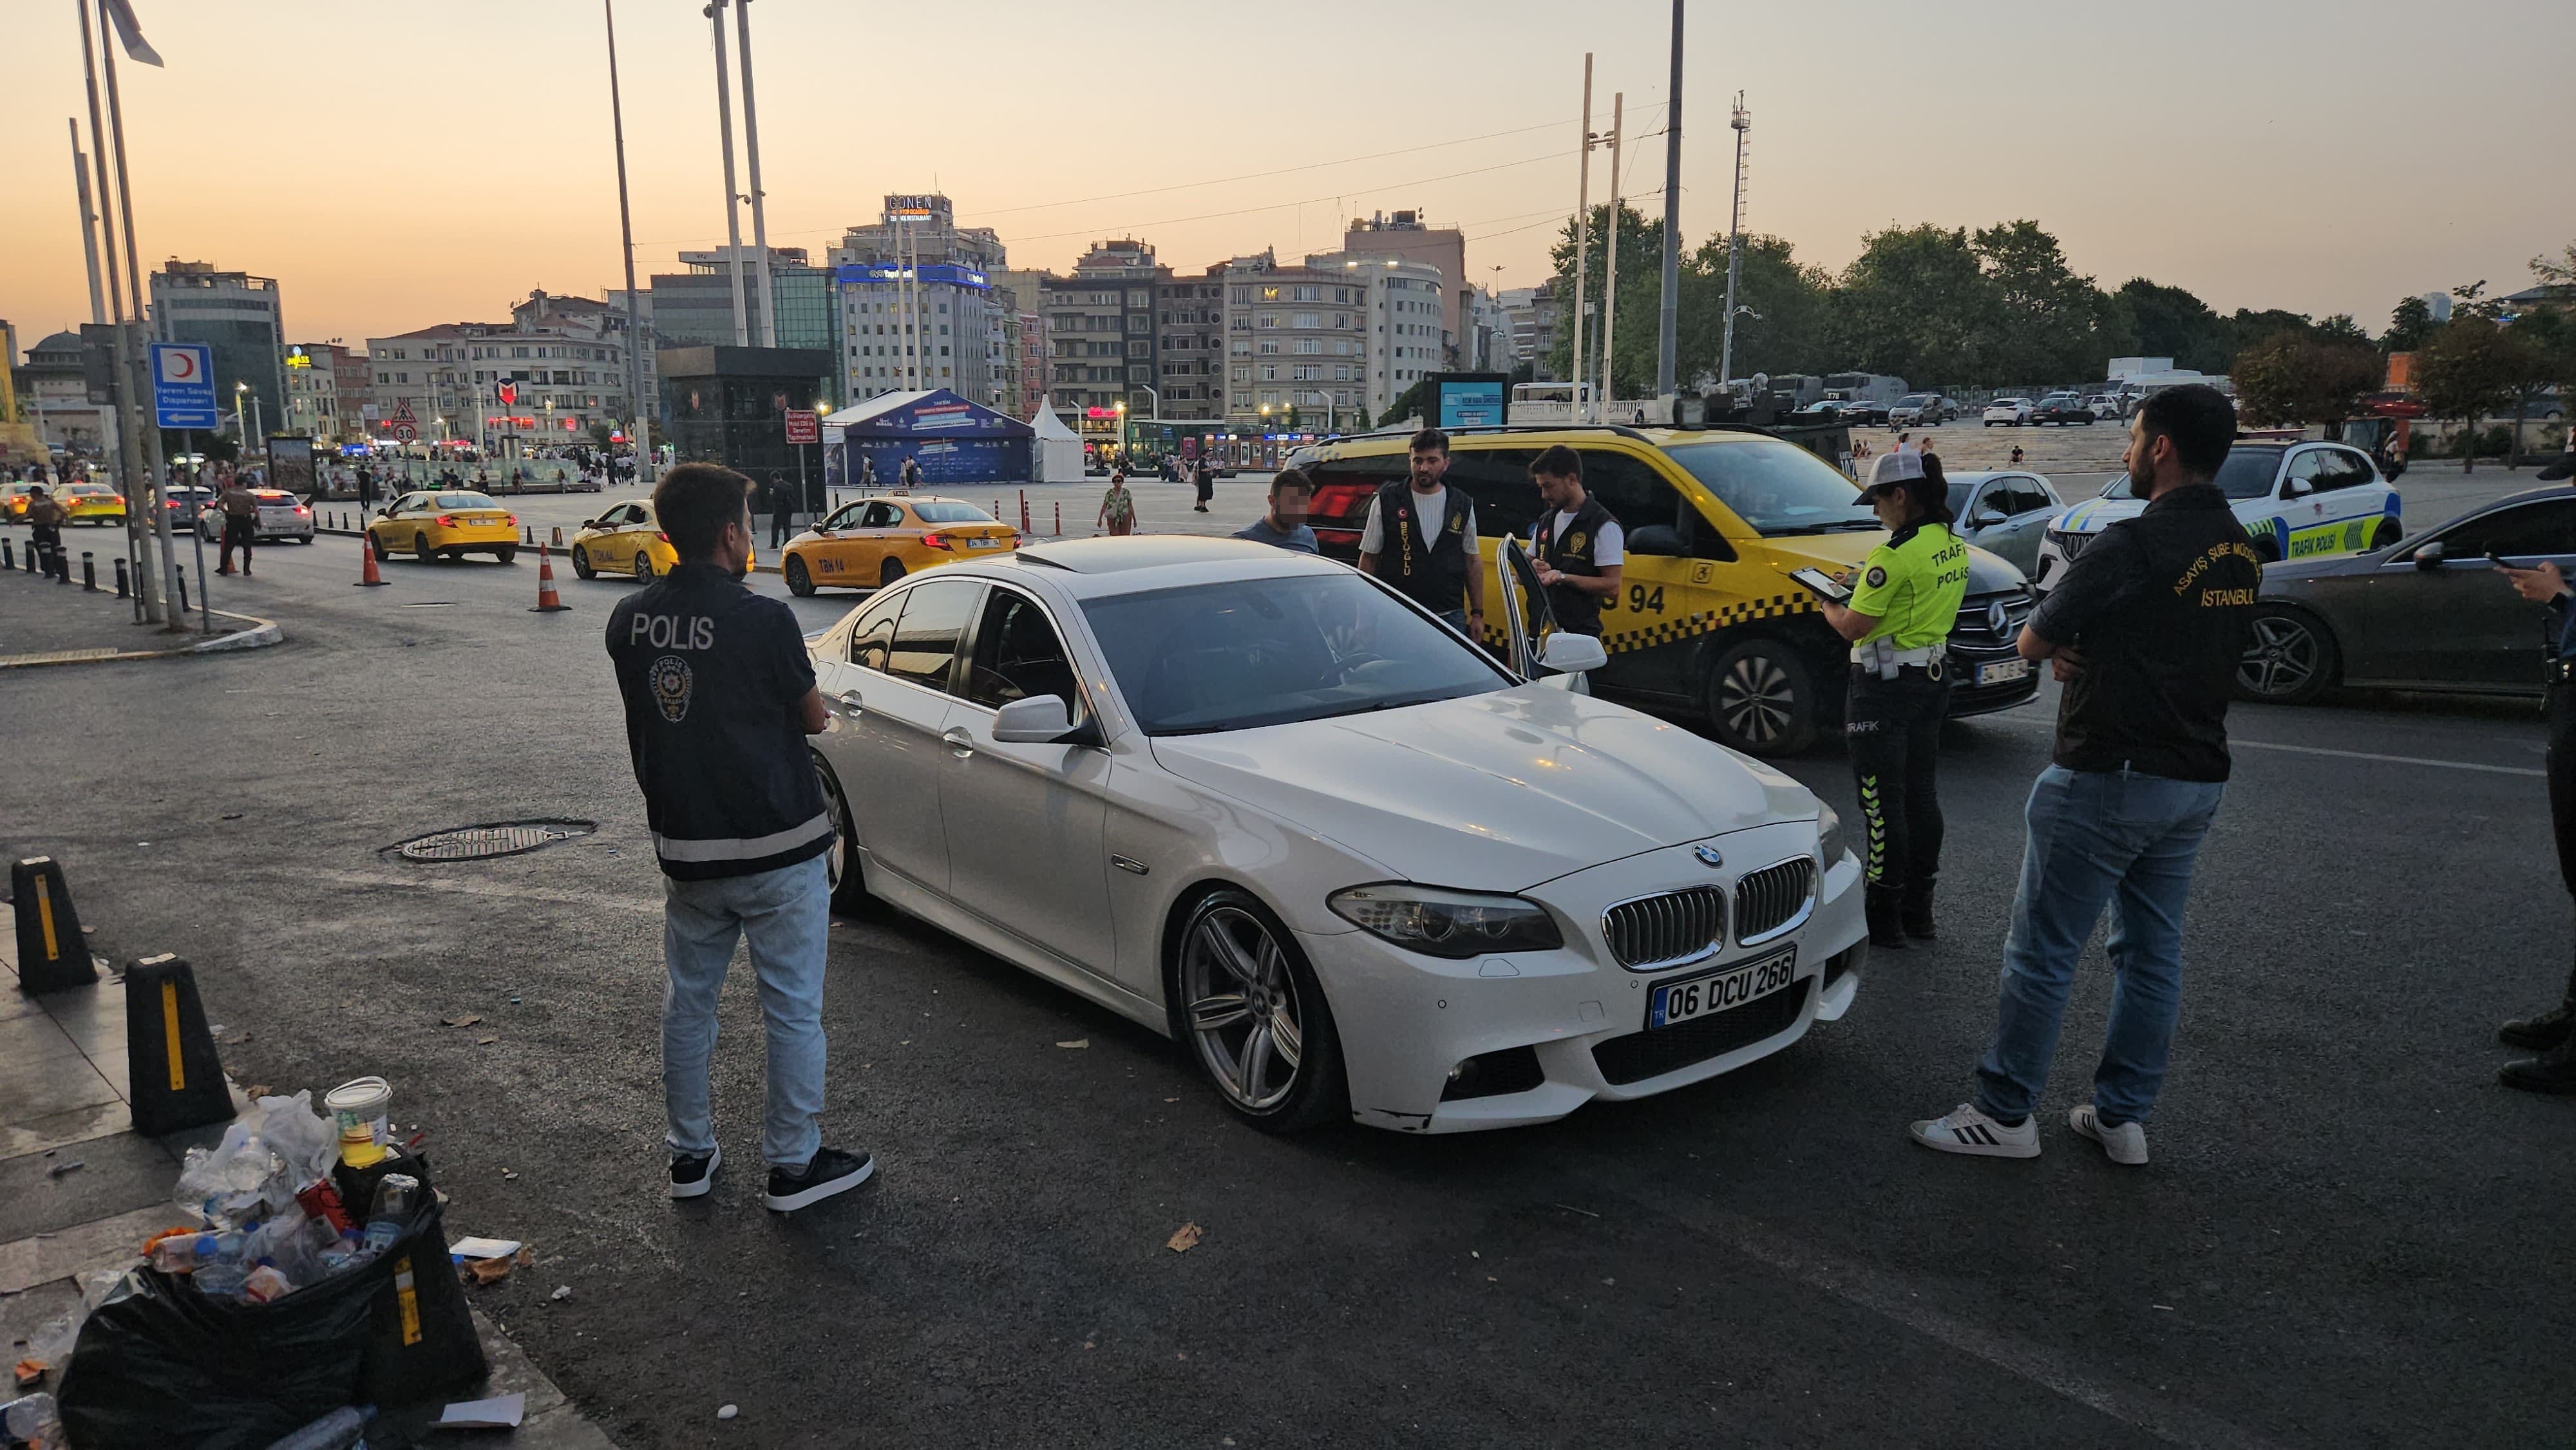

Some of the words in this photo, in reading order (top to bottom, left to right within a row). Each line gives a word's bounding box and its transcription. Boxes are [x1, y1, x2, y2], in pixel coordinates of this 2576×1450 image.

[398, 429, 413, 439] 30
[1931, 543, 1966, 567] TRAFİ
[1629, 584, 1665, 615] 94
[2201, 587, 2254, 607] İSTANBUL
[1654, 1009, 1665, 1020] TR
[1668, 984, 1700, 1019] 06
[1707, 970, 1753, 1010] DCU
[1754, 955, 1792, 996] 266
